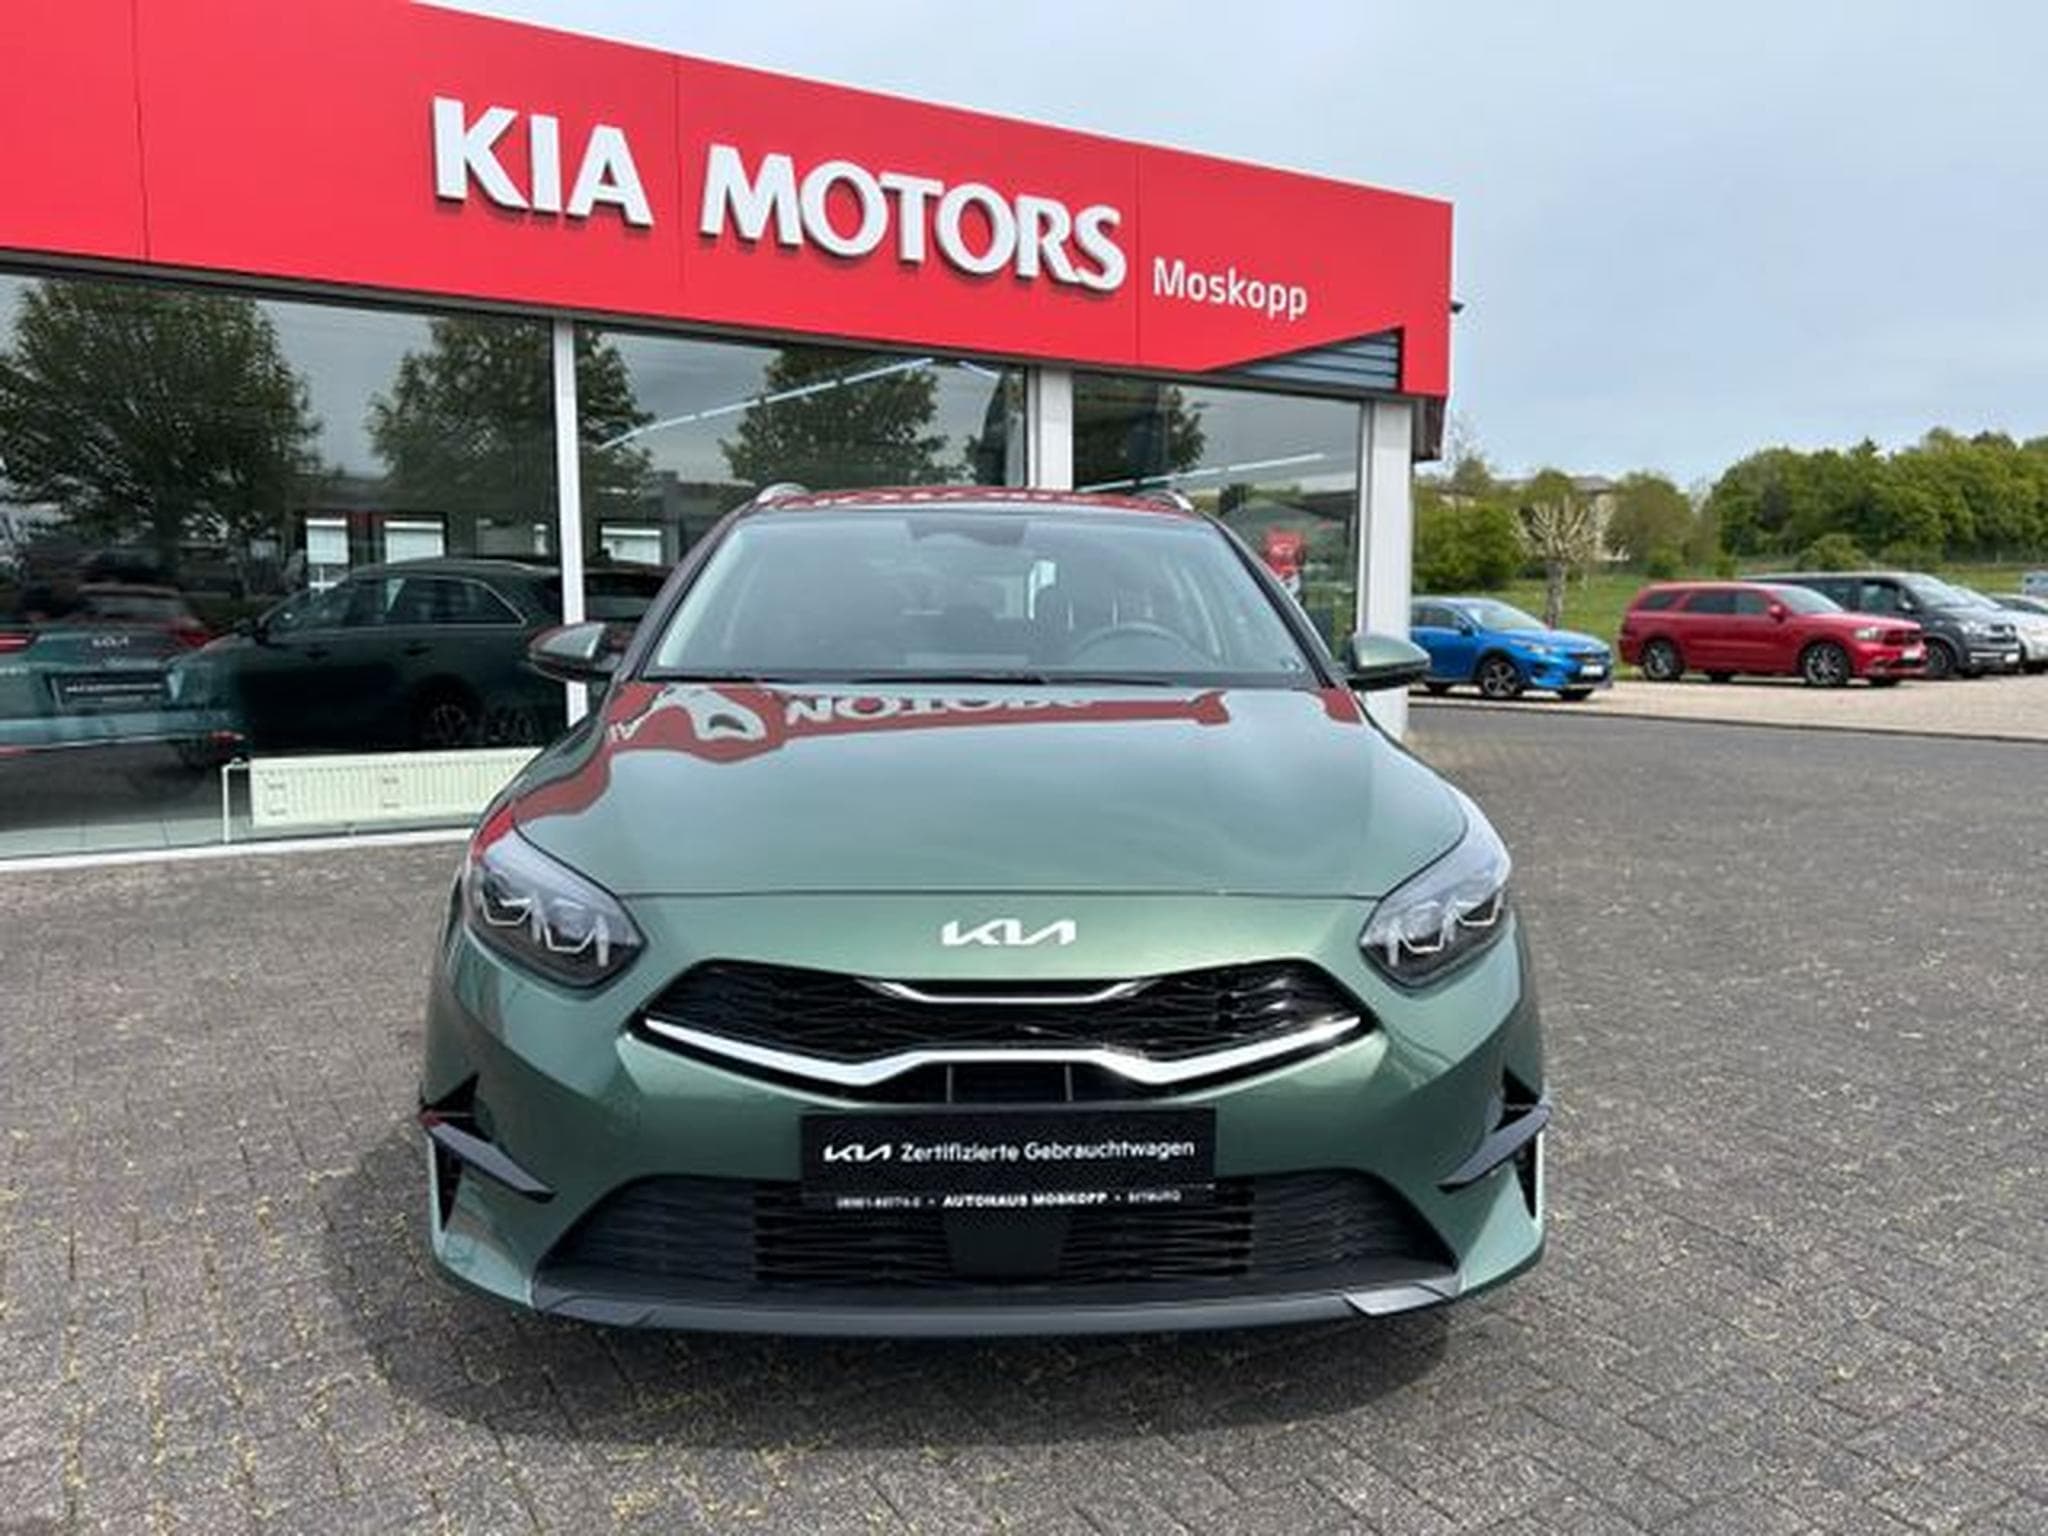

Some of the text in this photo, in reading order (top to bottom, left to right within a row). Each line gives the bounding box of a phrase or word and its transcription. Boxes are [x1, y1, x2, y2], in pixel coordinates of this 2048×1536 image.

[433, 95, 1127, 291] KIA MOTORS
[1153, 256, 1308, 321] Moskopp
[941, 917, 1077, 946] KIA
[824, 1139, 1196, 1163] KIA Zertifizierte Gebrauchtwagen
[942, 1194, 1028, 1208] AUTOHAUS
[1032, 1191, 1108, 1206] MOSKOPP
